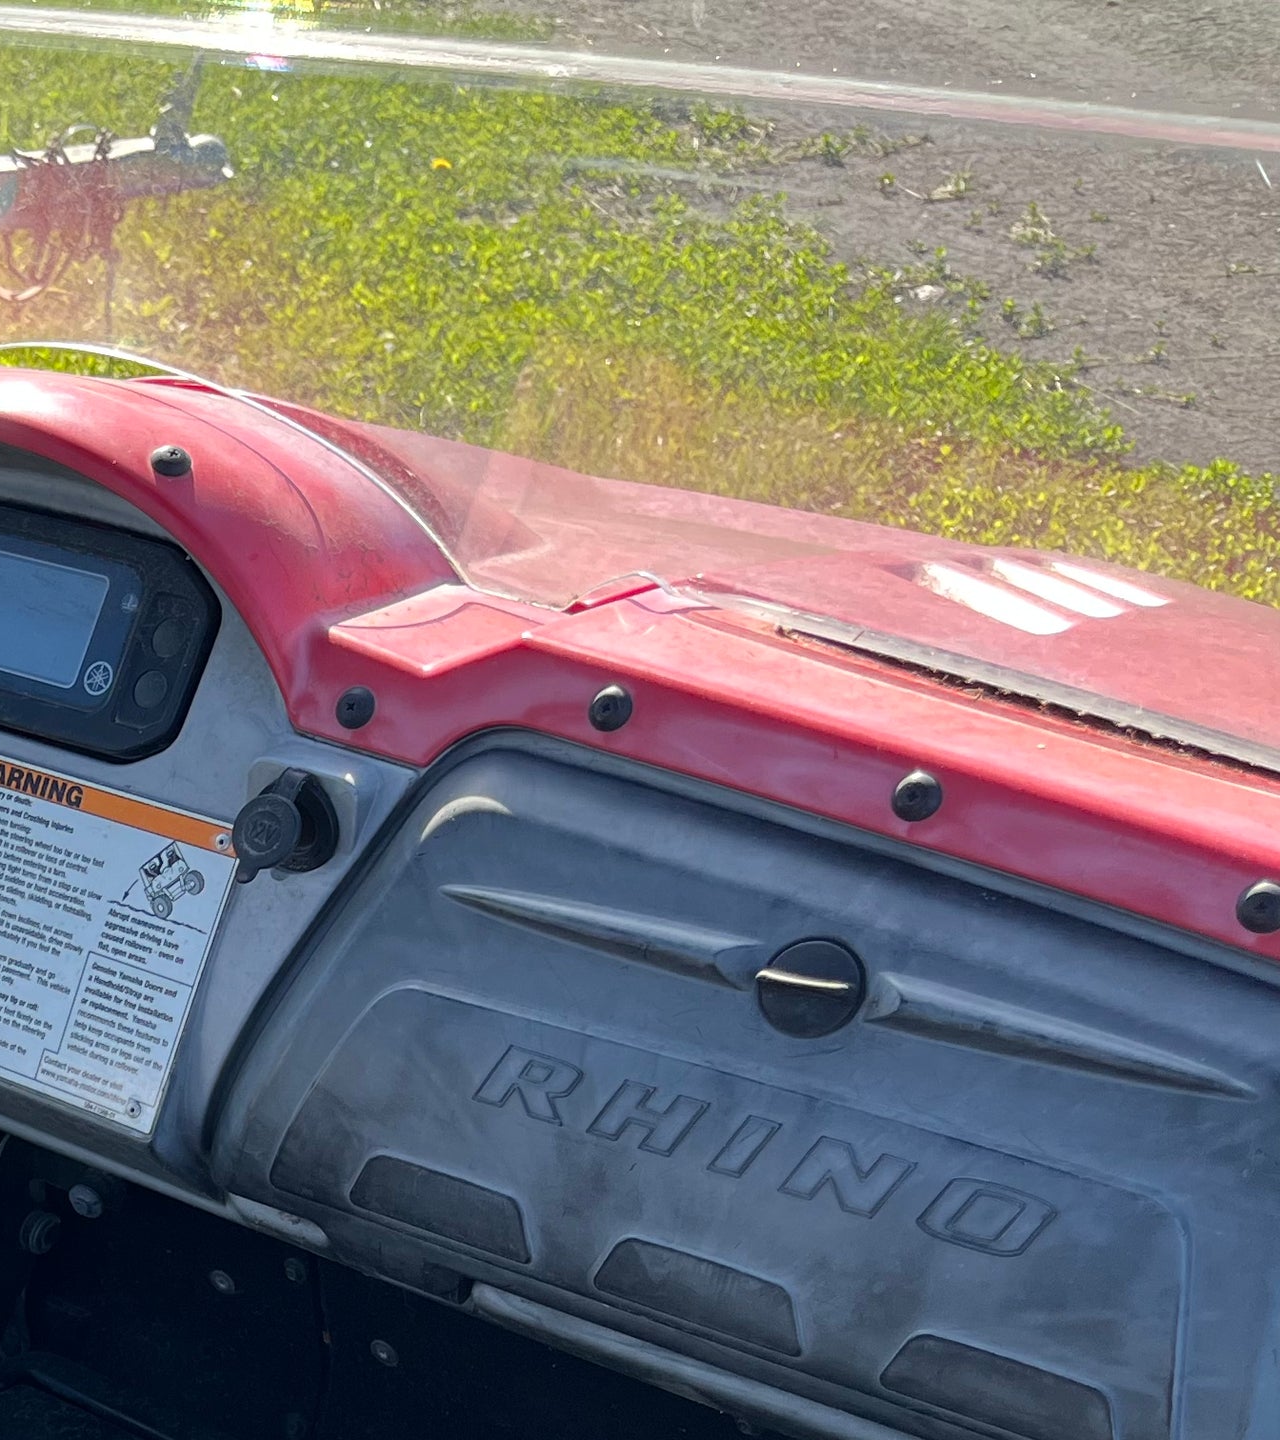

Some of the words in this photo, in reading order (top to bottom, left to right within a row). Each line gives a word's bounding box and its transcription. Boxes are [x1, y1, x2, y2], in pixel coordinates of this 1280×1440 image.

[9, 807, 23, 818] and
[21, 811, 50, 828] Crushing
[49, 819, 74, 836] Injuries
[103, 919, 139, 938] aggressive
[138, 930, 162, 945] driving
[162, 938, 180, 950] have
[107, 907, 130, 922] Abrupt
[130, 916, 166, 933] maneuvers
[100, 929, 124, 944] caused
[124, 937, 153, 953] rollovers
[158, 950, 174, 960] even
[110, 946, 127, 959] open
[91, 961, 118, 976] Genuine
[118, 970, 144, 985] Yamaha
[143, 979, 164, 992] Doors
[164, 986, 178, 997] and
[92, 975, 143, 1000] Handhold/Strap
[142, 993, 154, 1003] are
[8, 994, 18, 1005] tip
[84, 984, 113, 1000] available
[112, 994, 123, 1004] for
[123, 998, 137, 1009] free
[137, 1003, 174, 1022] installation
[131, 1014, 158, 1030] Yamaha
[473, 1044, 1056, 1257] RHINO
